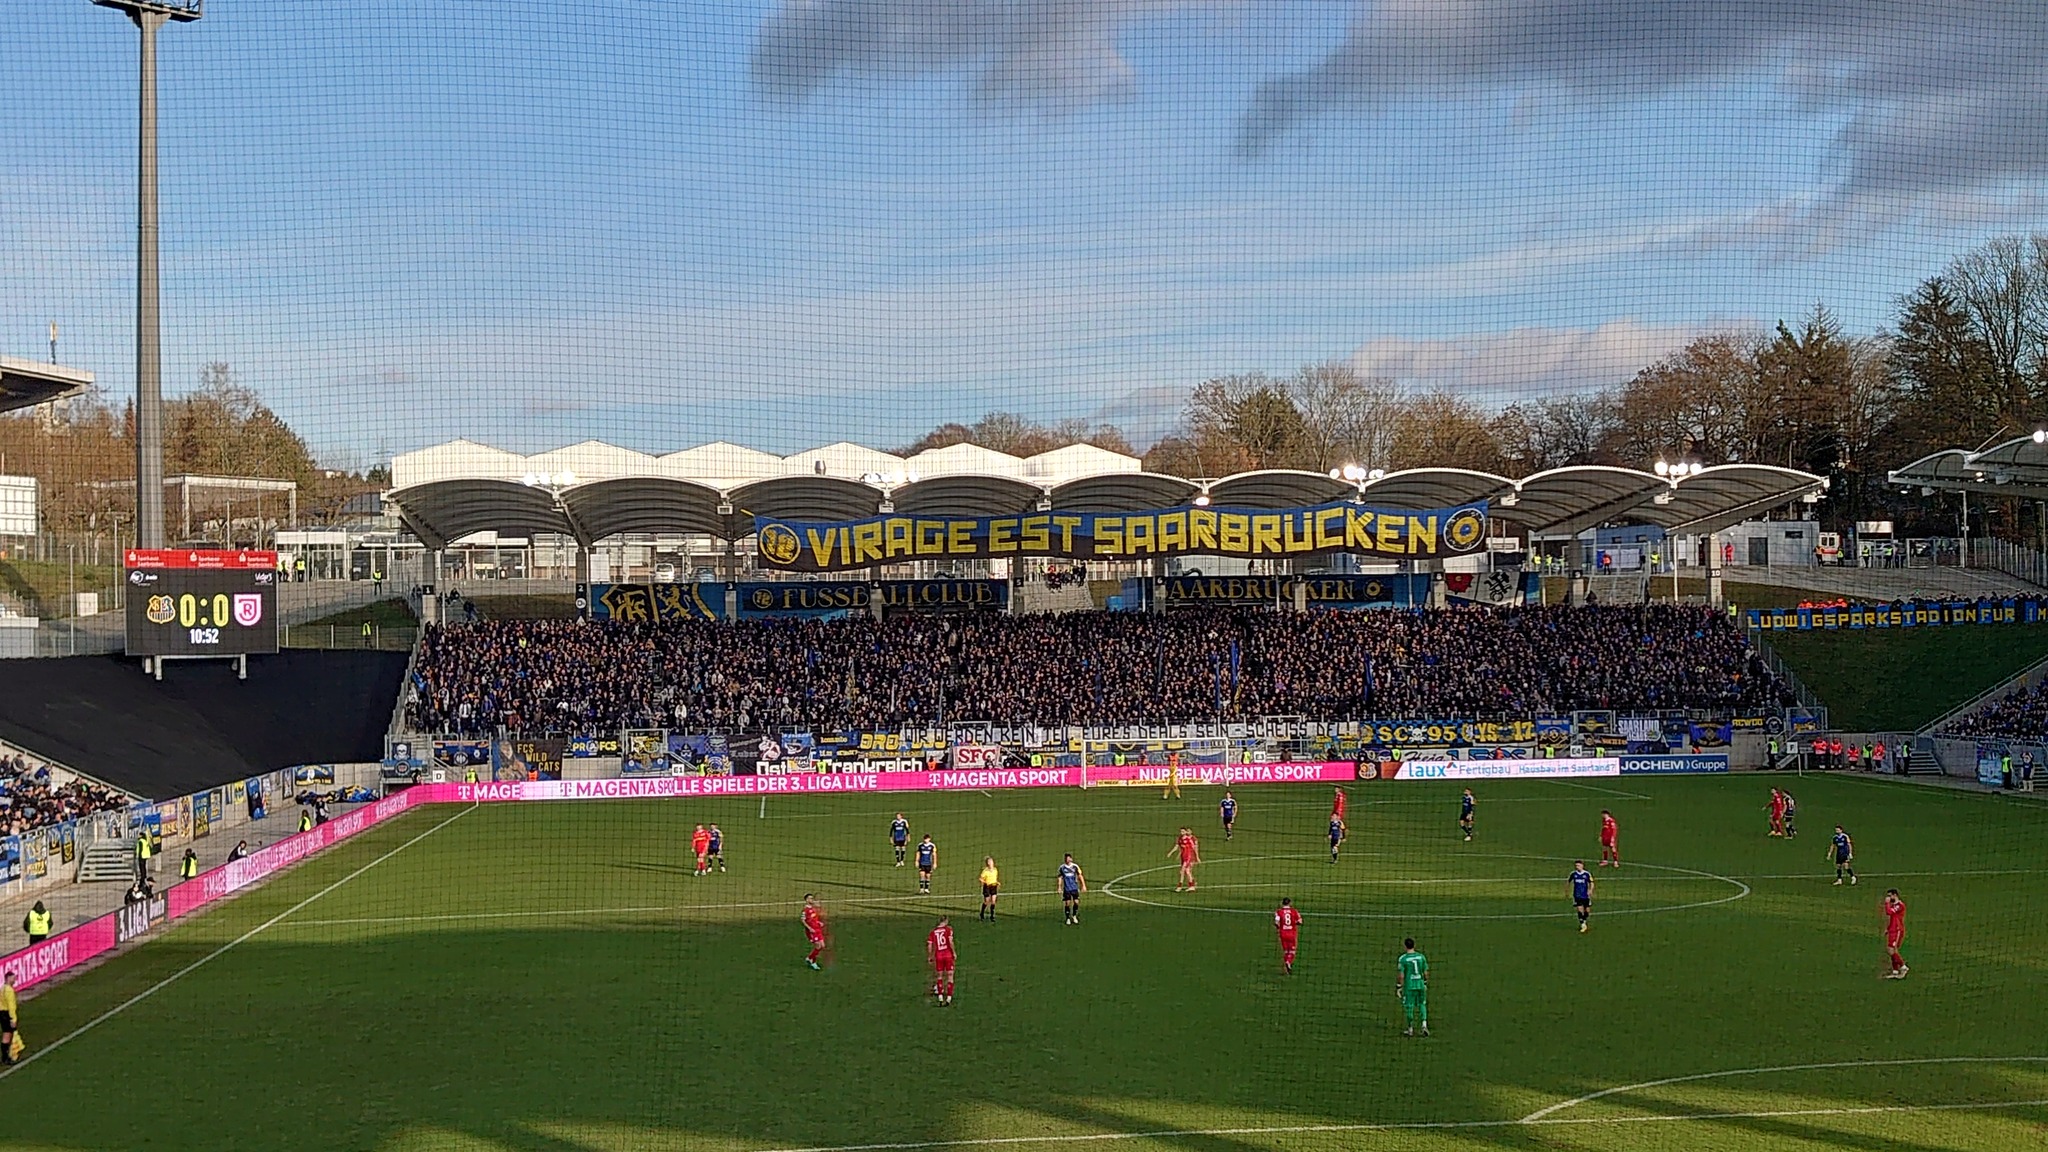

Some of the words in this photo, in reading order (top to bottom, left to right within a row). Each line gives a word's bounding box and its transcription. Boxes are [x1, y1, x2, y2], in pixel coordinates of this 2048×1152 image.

[807, 518, 977, 566] VIRAGE
[989, 515, 1082, 553] EST
[1094, 507, 1437, 554] SAARBRÜCKEN
[190, 629, 219, 643] 10:52
[1378, 726, 1408, 742] SC
[1427, 726, 1457, 742] 95
[517, 743, 535, 754] FCS
[600, 740, 618, 751] FCS
[525, 752, 548, 763] WILD
[1621, 760, 1684, 771] JOCHEM
[1691, 759, 1726, 771] Gruppe
[539, 762, 560, 772] CATS
[1200, 767, 1272, 780] MAGENTA
[1274, 765, 1323, 779] SPORT
[1408, 762, 1447, 777] laux
[1459, 763, 1511, 776] Fertigbau
[703, 777, 753, 791] SPIELE
[757, 777, 788, 791] DER
[791, 776, 804, 790] 3.
[808, 776, 842, 789] LIGA
[846, 775, 877, 788] LIVE
[943, 771, 1018, 786] MAGENTA
[1019, 770, 1068, 785] SPORT
[576, 780, 657, 797] MAGENTA
[128, 900, 149, 938] LIGA
[1285, 913, 1292, 925] 8
[935, 931, 946, 945] 16
[39, 938, 69, 975] SPORT
[1412, 959, 1419, 974] 1
